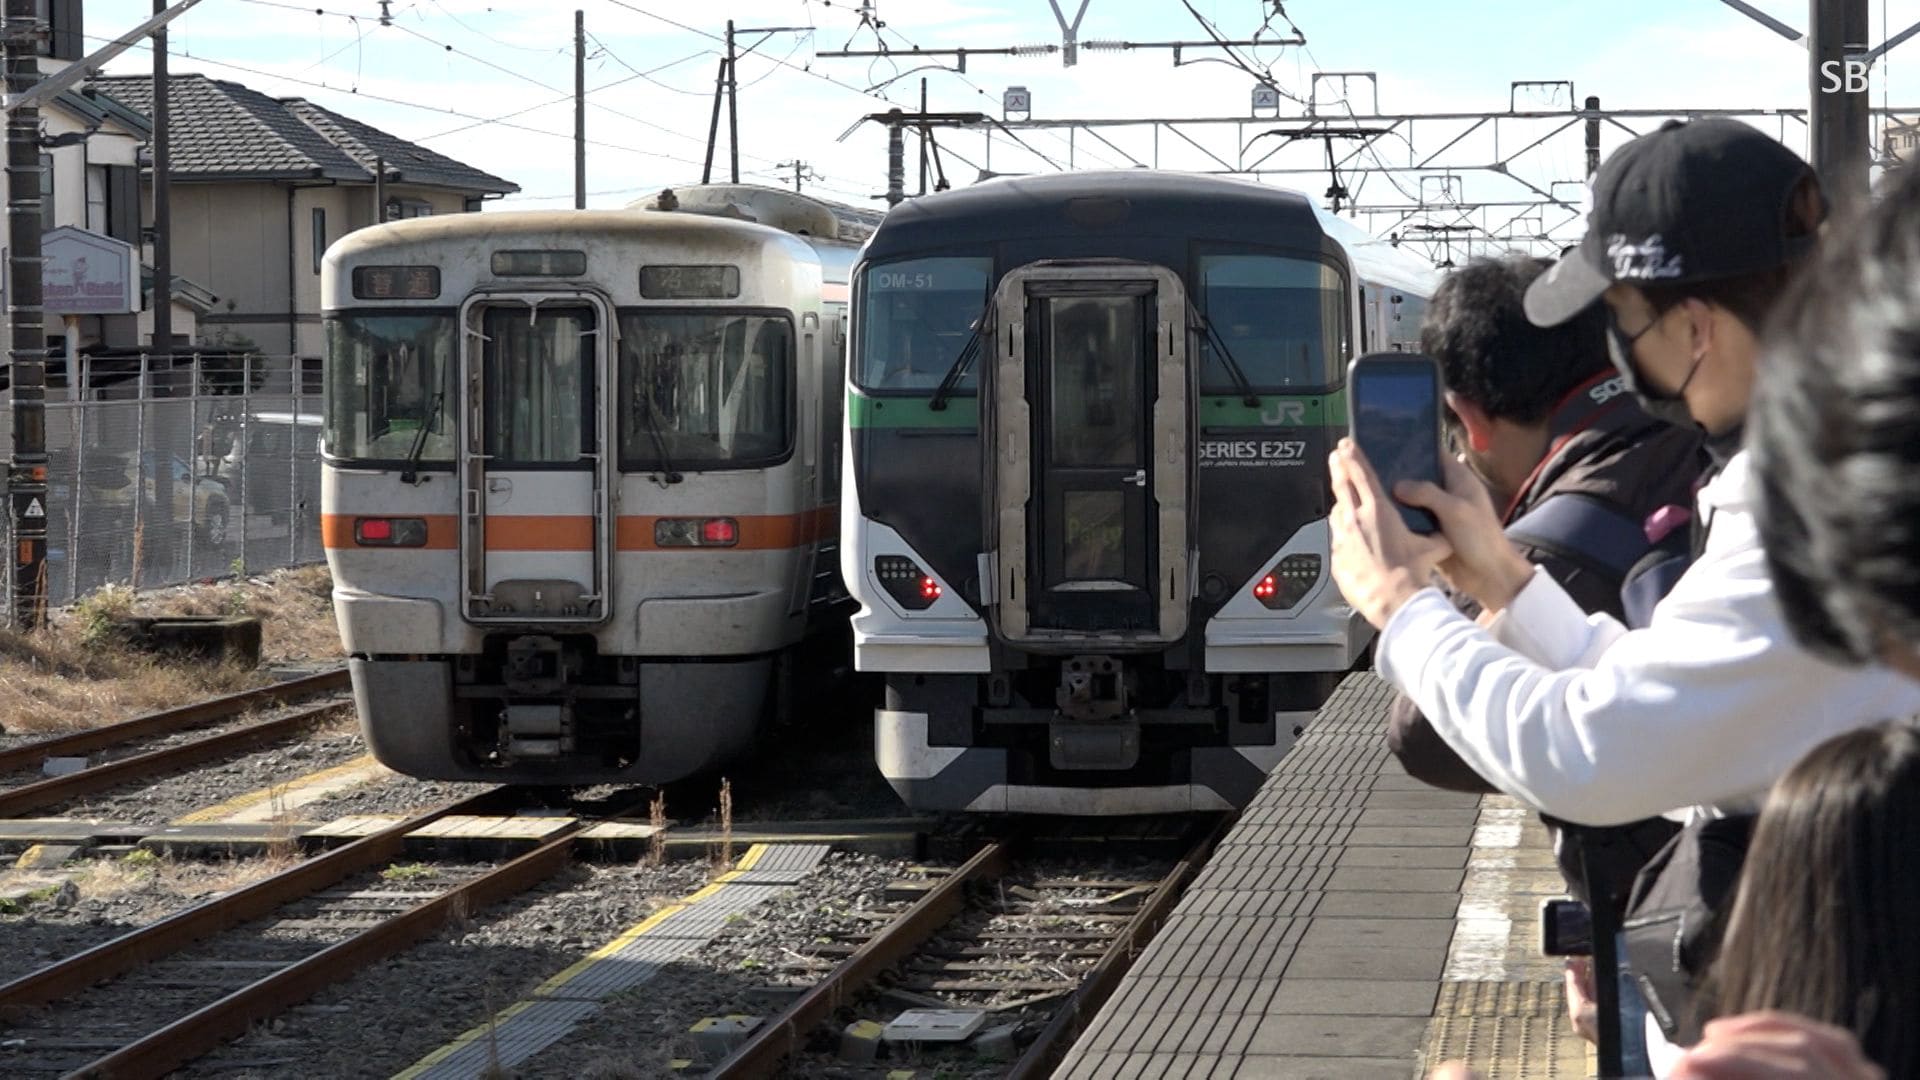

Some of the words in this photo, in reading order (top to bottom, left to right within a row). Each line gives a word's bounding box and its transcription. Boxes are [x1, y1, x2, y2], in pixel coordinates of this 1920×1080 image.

[879, 273, 933, 288] OM-51
[1261, 400, 1305, 426] JR
[1261, 441, 1306, 458] E257
